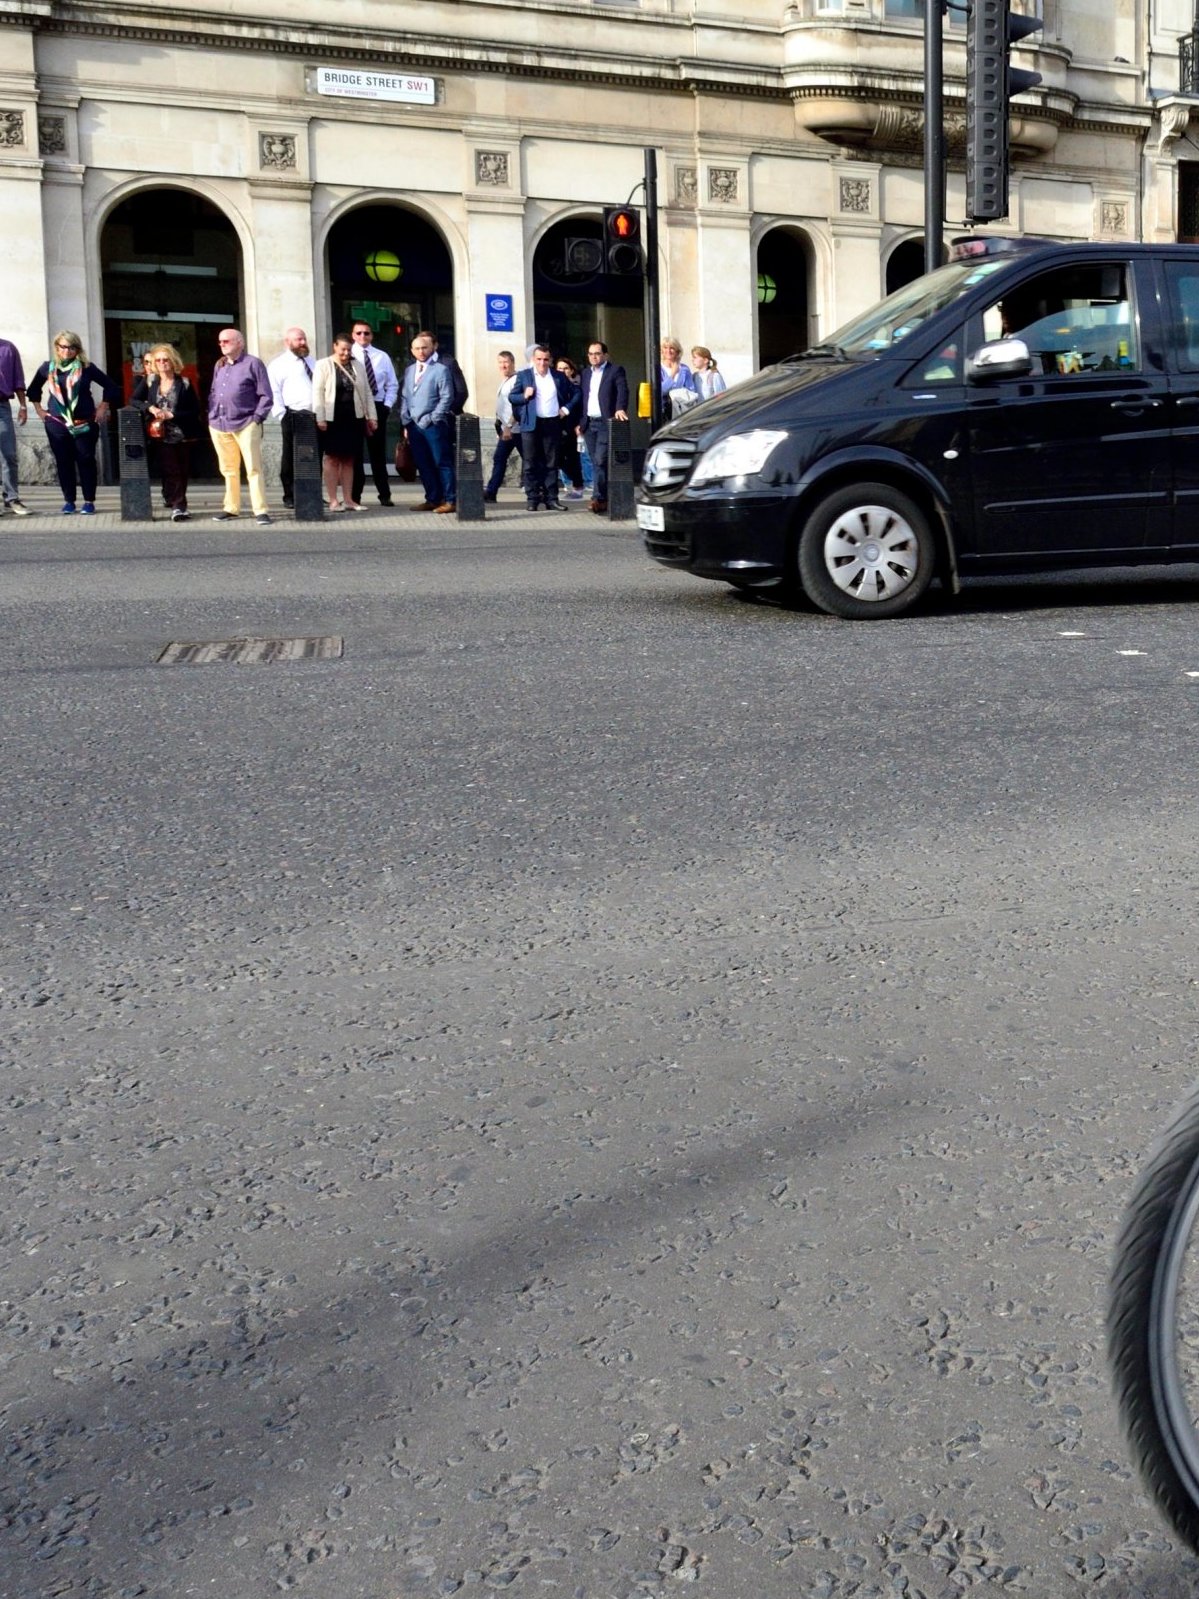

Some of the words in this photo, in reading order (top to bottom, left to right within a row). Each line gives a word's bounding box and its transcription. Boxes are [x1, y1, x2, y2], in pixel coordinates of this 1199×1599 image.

[324, 73, 362, 85] BRIDGE
[366, 77, 403, 89] STREET
[407, 80, 428, 91] SW1
